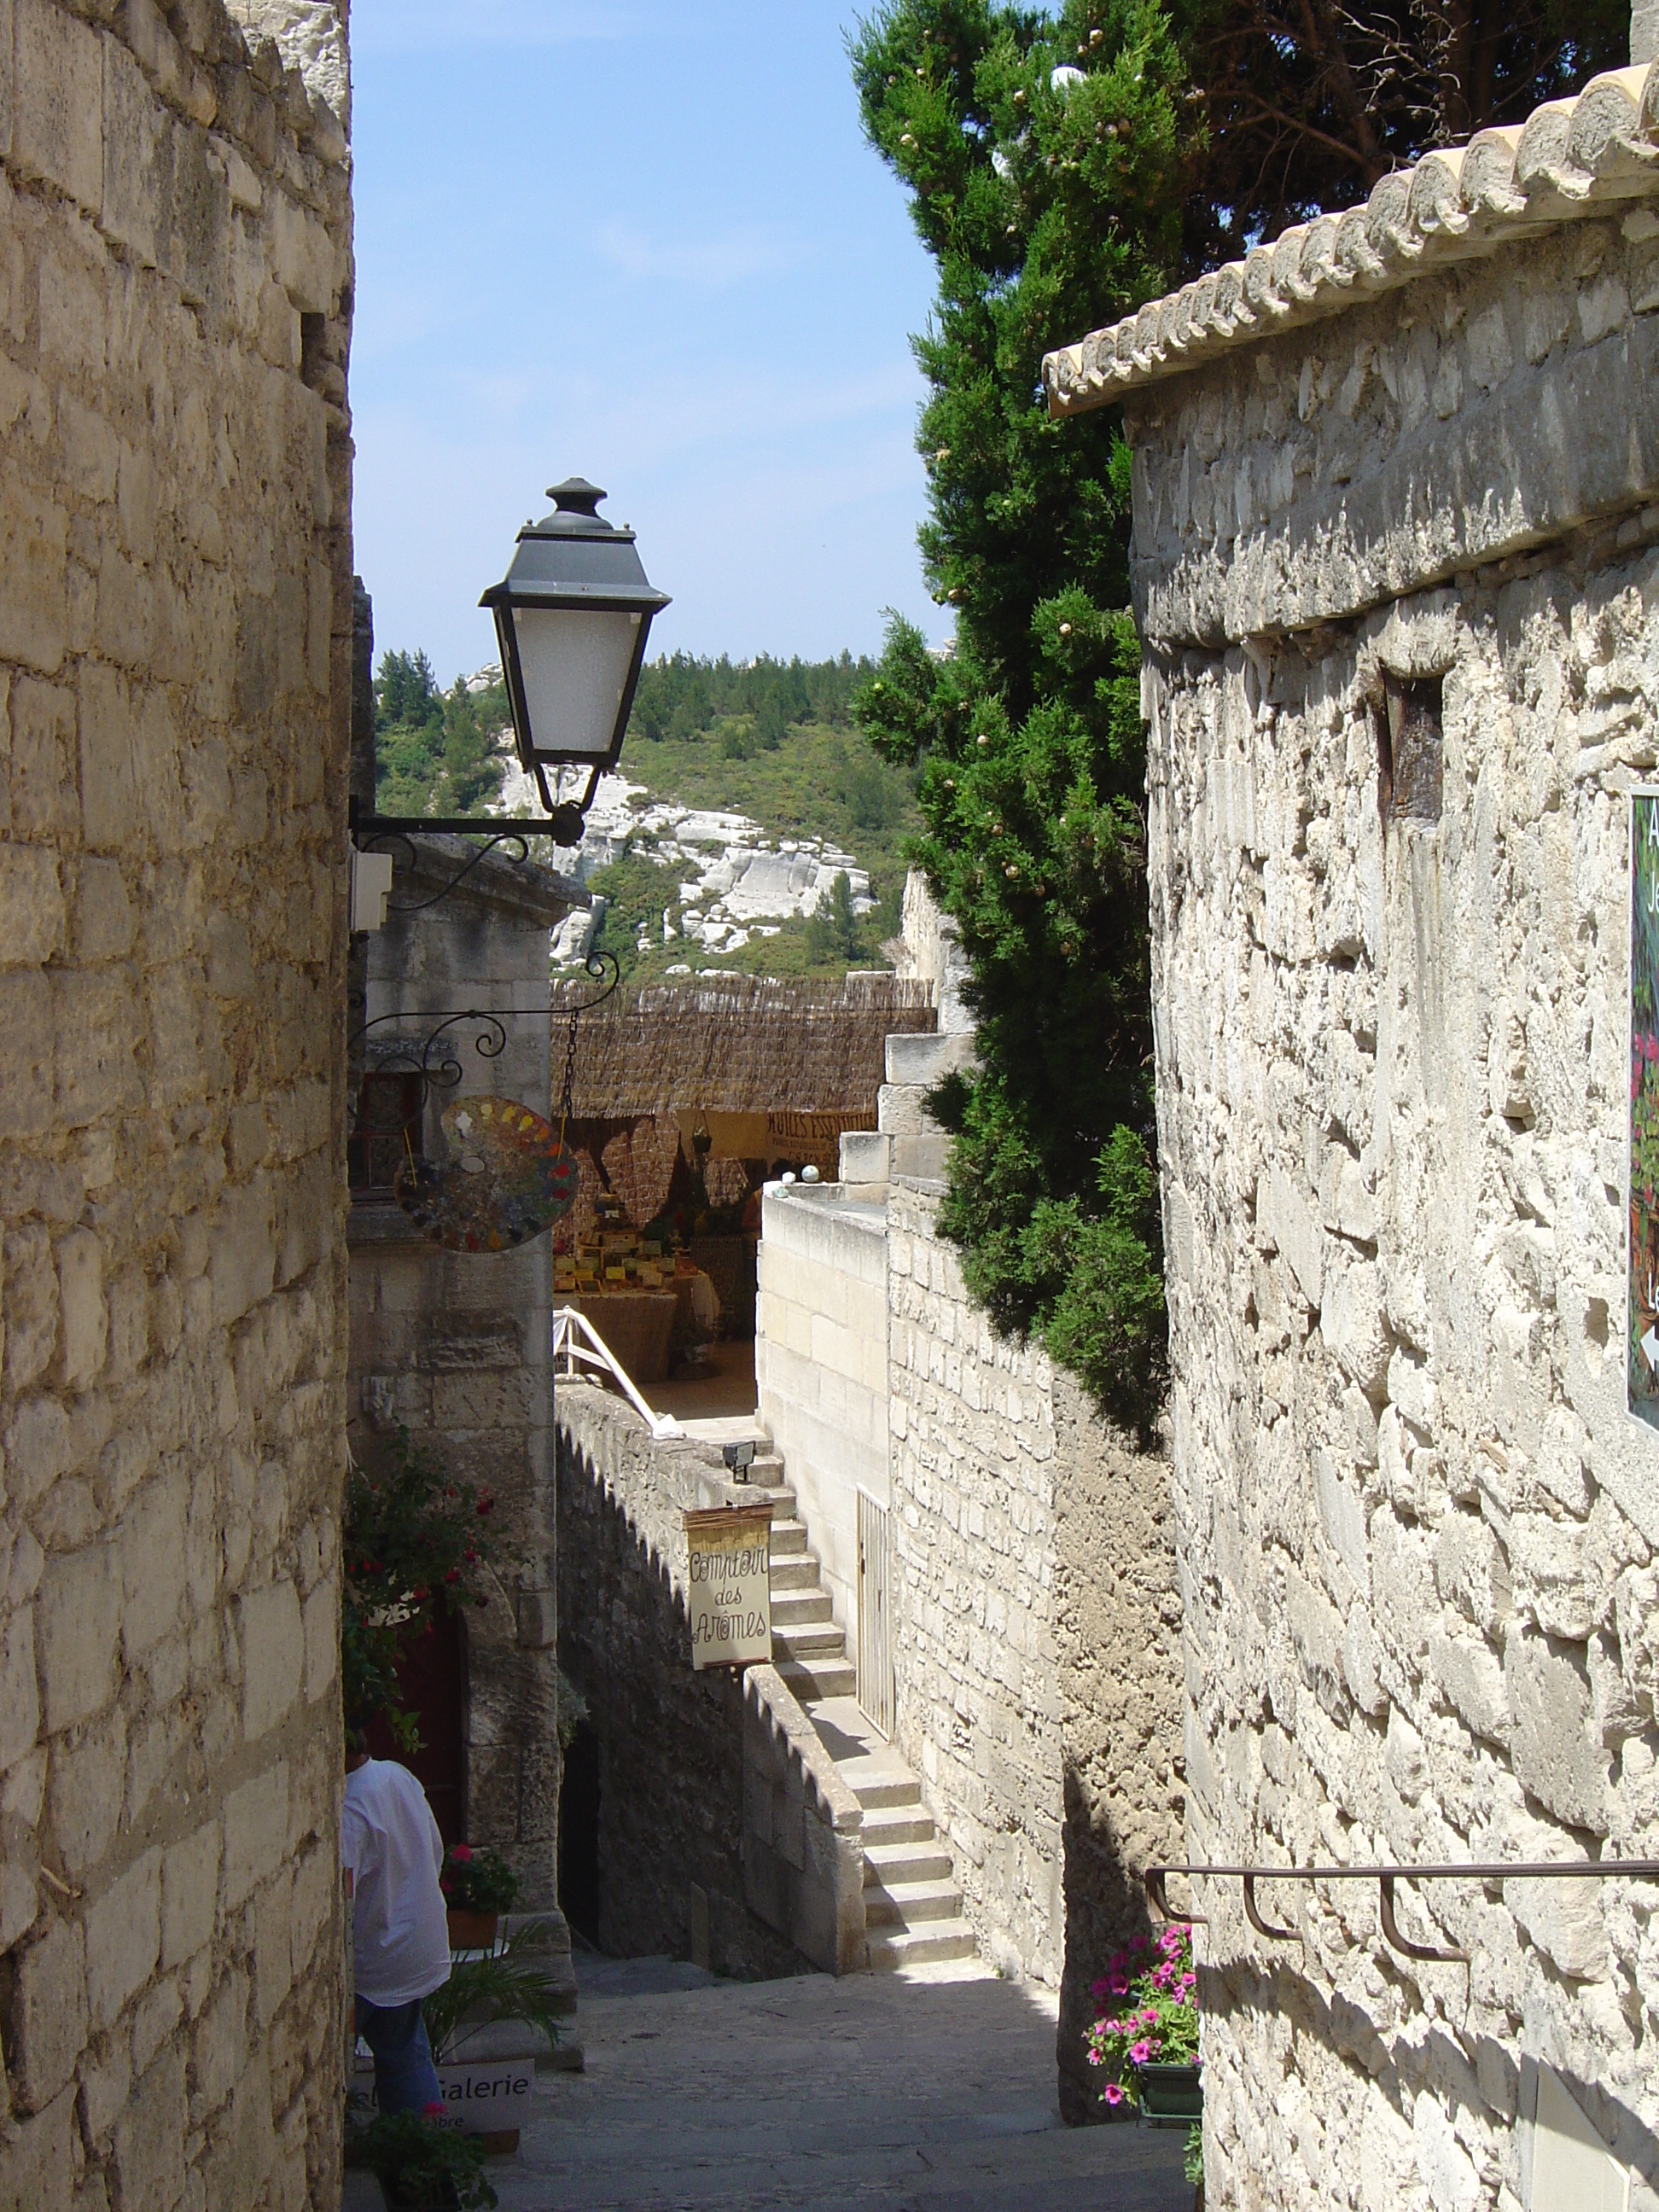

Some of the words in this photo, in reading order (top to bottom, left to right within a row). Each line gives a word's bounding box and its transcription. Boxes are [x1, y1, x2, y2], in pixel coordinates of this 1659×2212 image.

[769, 1112, 807, 1138] HUILES
[690, 1546, 768, 1585] Comptoir
[714, 1586, 742, 1607] des
[692, 1610, 766, 1644] Arômes
[430, 2116, 464, 2129] ibre
